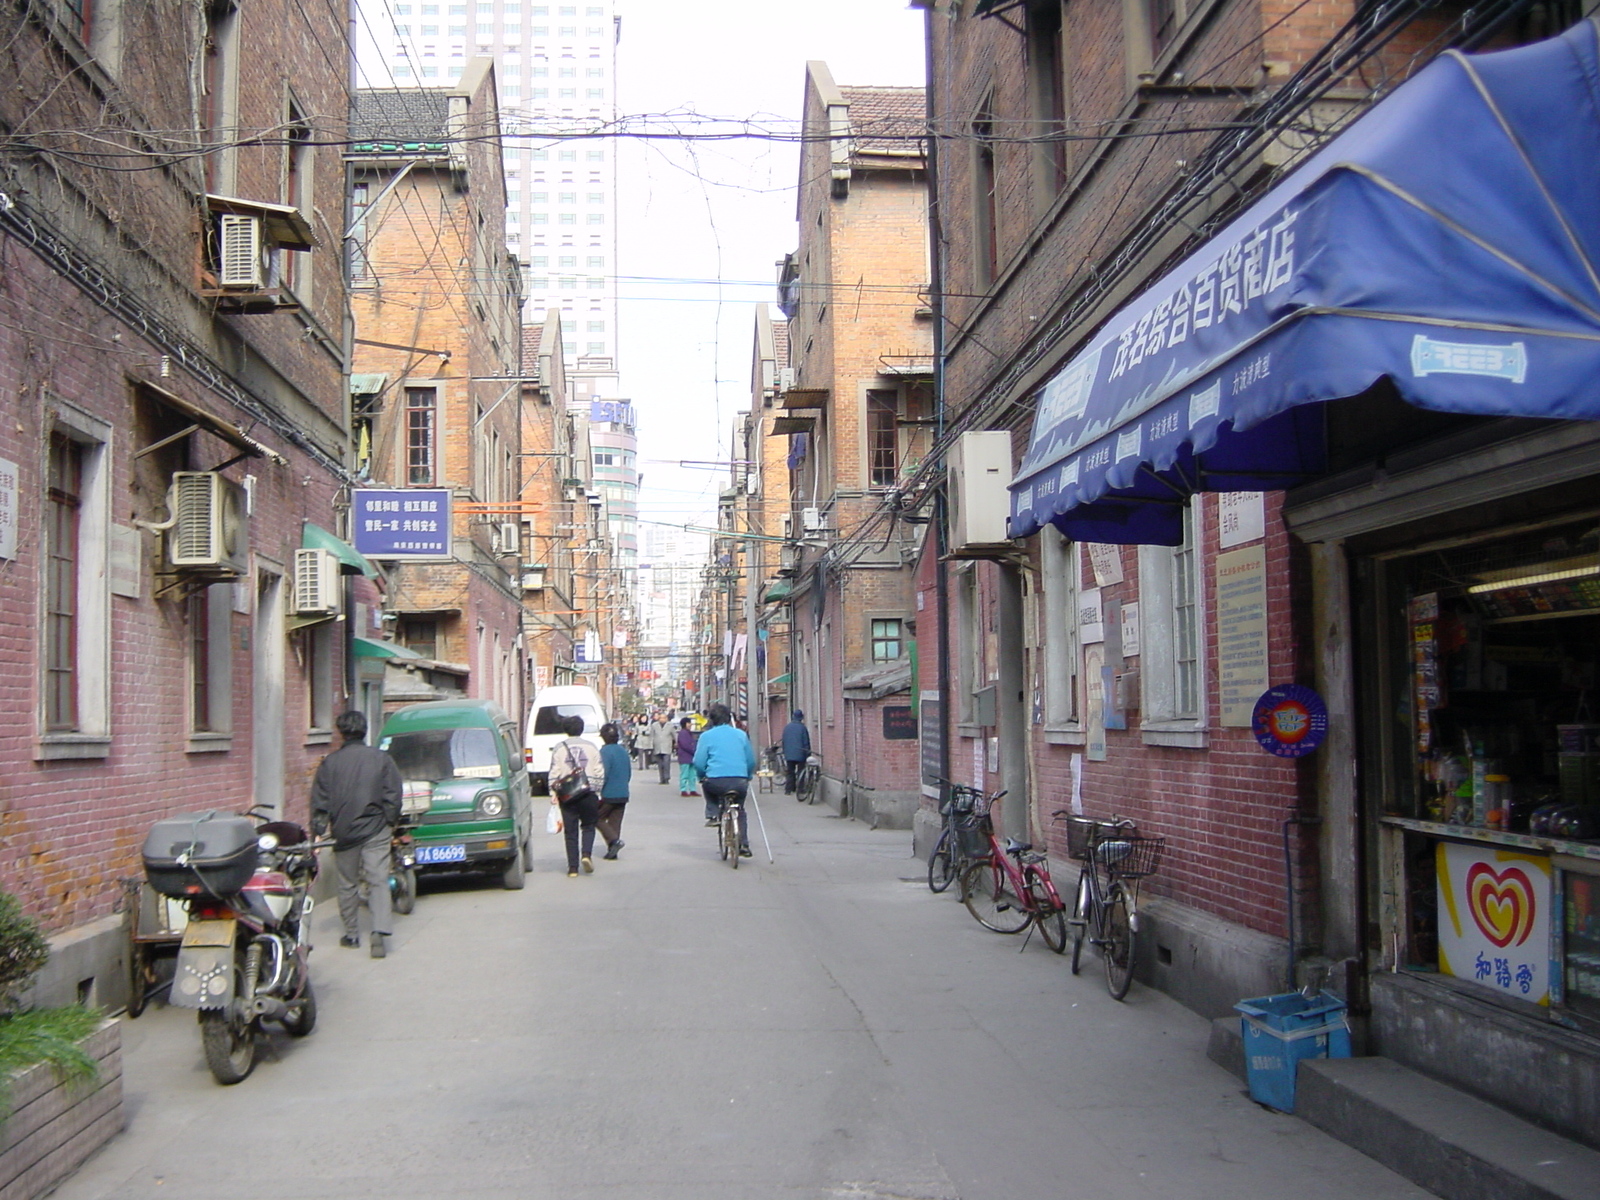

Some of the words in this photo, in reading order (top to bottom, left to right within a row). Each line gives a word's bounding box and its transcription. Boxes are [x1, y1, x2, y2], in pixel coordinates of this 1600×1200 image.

[1108, 208, 1299, 383] 茂名综合百货商店
[365, 520, 399, 532] 警民一家
[403, 520, 438, 532] 共创安全
[1475, 950, 1532, 994] 和路雪
